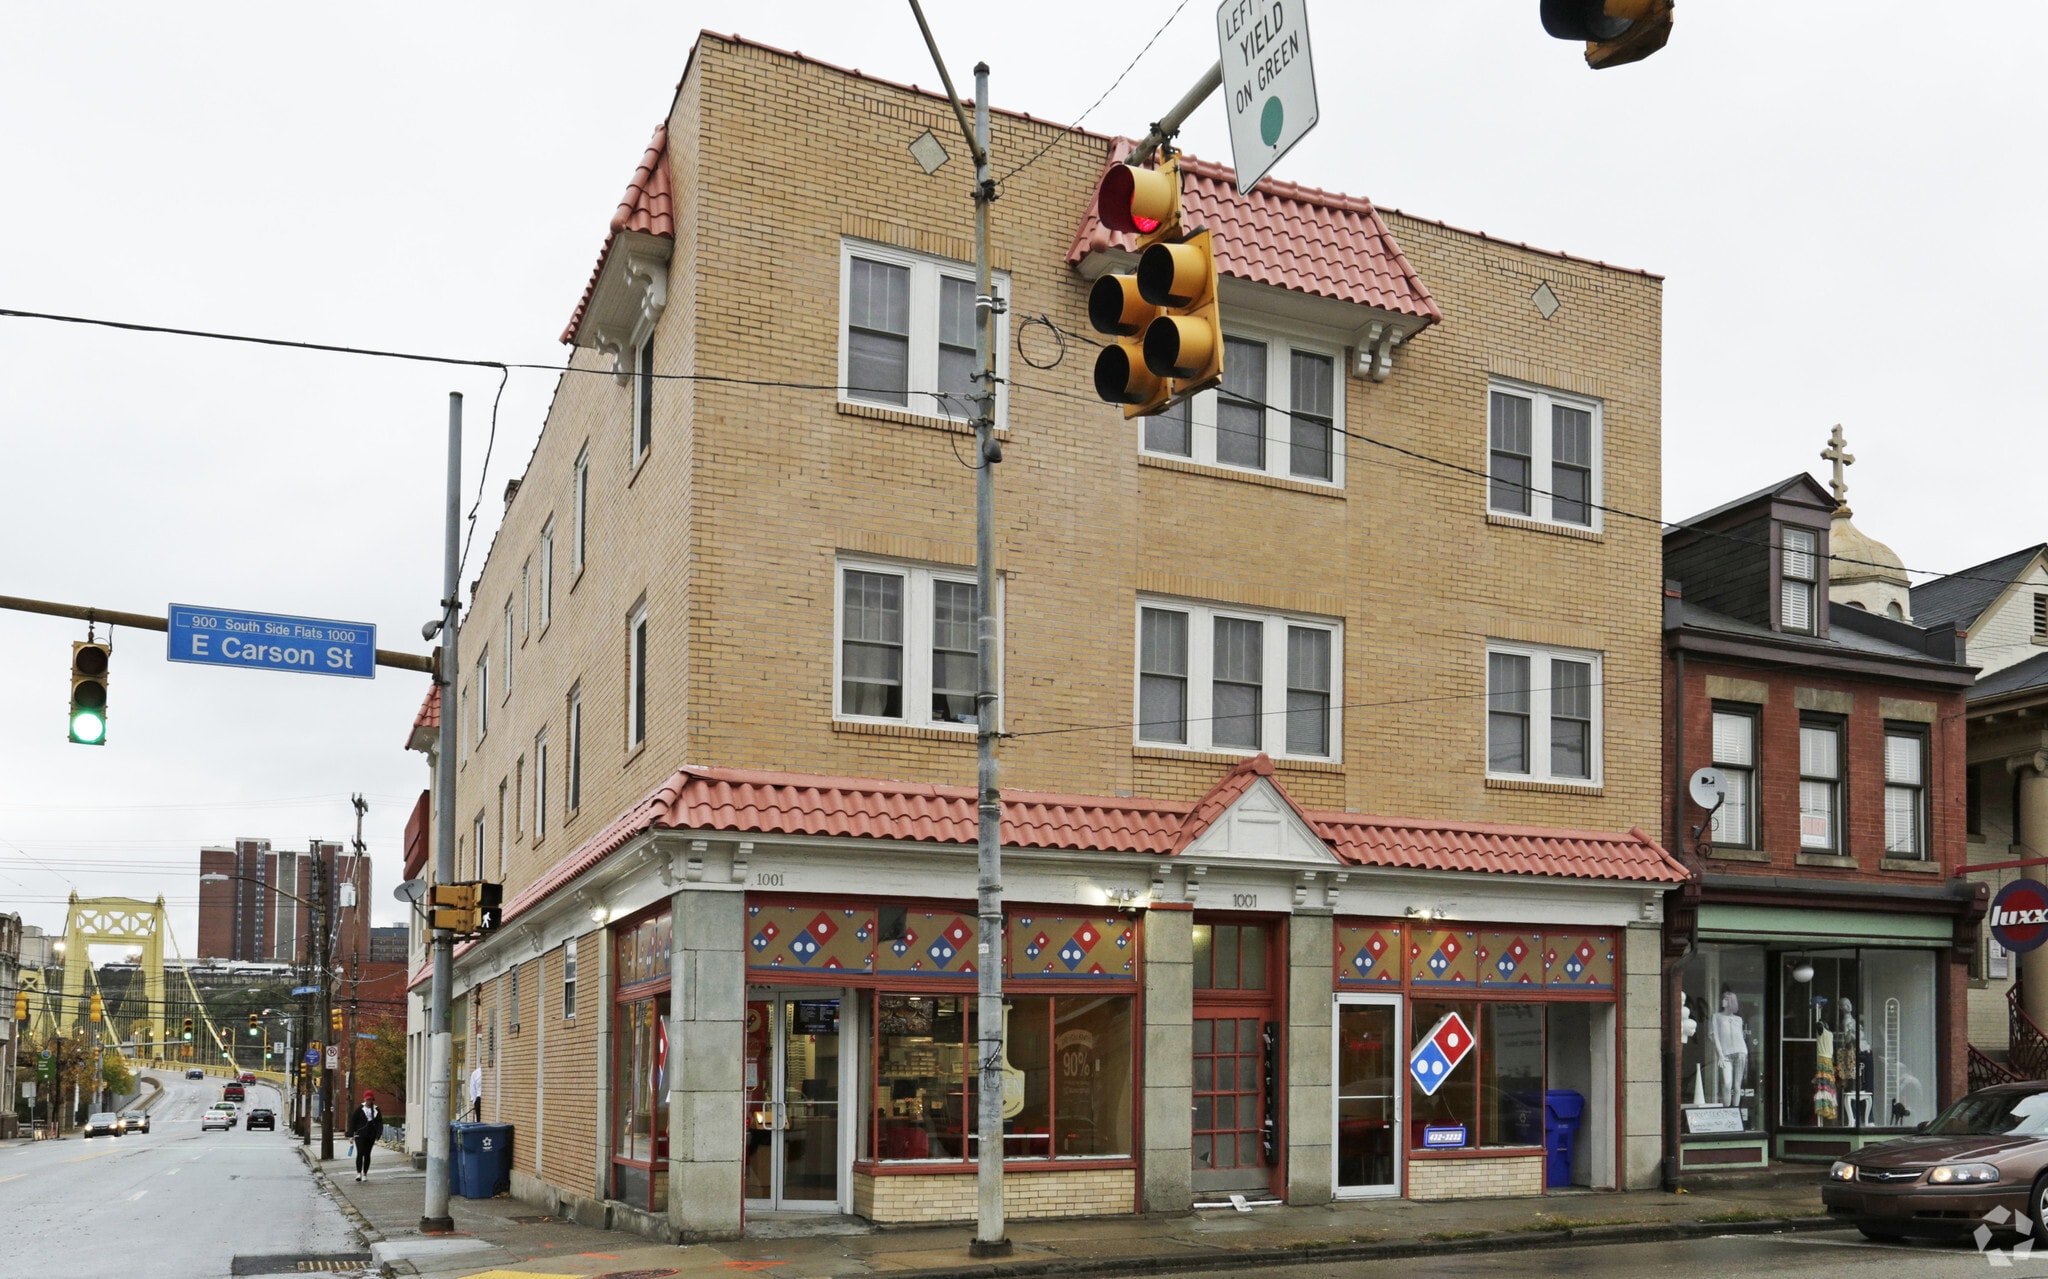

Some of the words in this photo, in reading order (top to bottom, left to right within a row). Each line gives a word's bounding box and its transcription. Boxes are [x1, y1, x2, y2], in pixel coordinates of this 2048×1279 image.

[1240, 1, 1284, 67] YIELD
[1236, 80, 1253, 114] ON
[1258, 29, 1299, 91] GREEN
[192, 616, 218, 628] 900
[225, 618, 260, 633] South
[265, 622, 290, 636] Side
[294, 625, 323, 639] Flats
[327, 629, 356, 642] 1000
[192, 633, 210, 656] E
[221, 636, 315, 665] Carson
[326, 646, 353, 669] St
[757, 873, 785, 887] 1001
[1233, 893, 1257, 908] 1001
[1990, 905, 2048, 927] luxx
[1063, 1052, 1090, 1077] 90%
